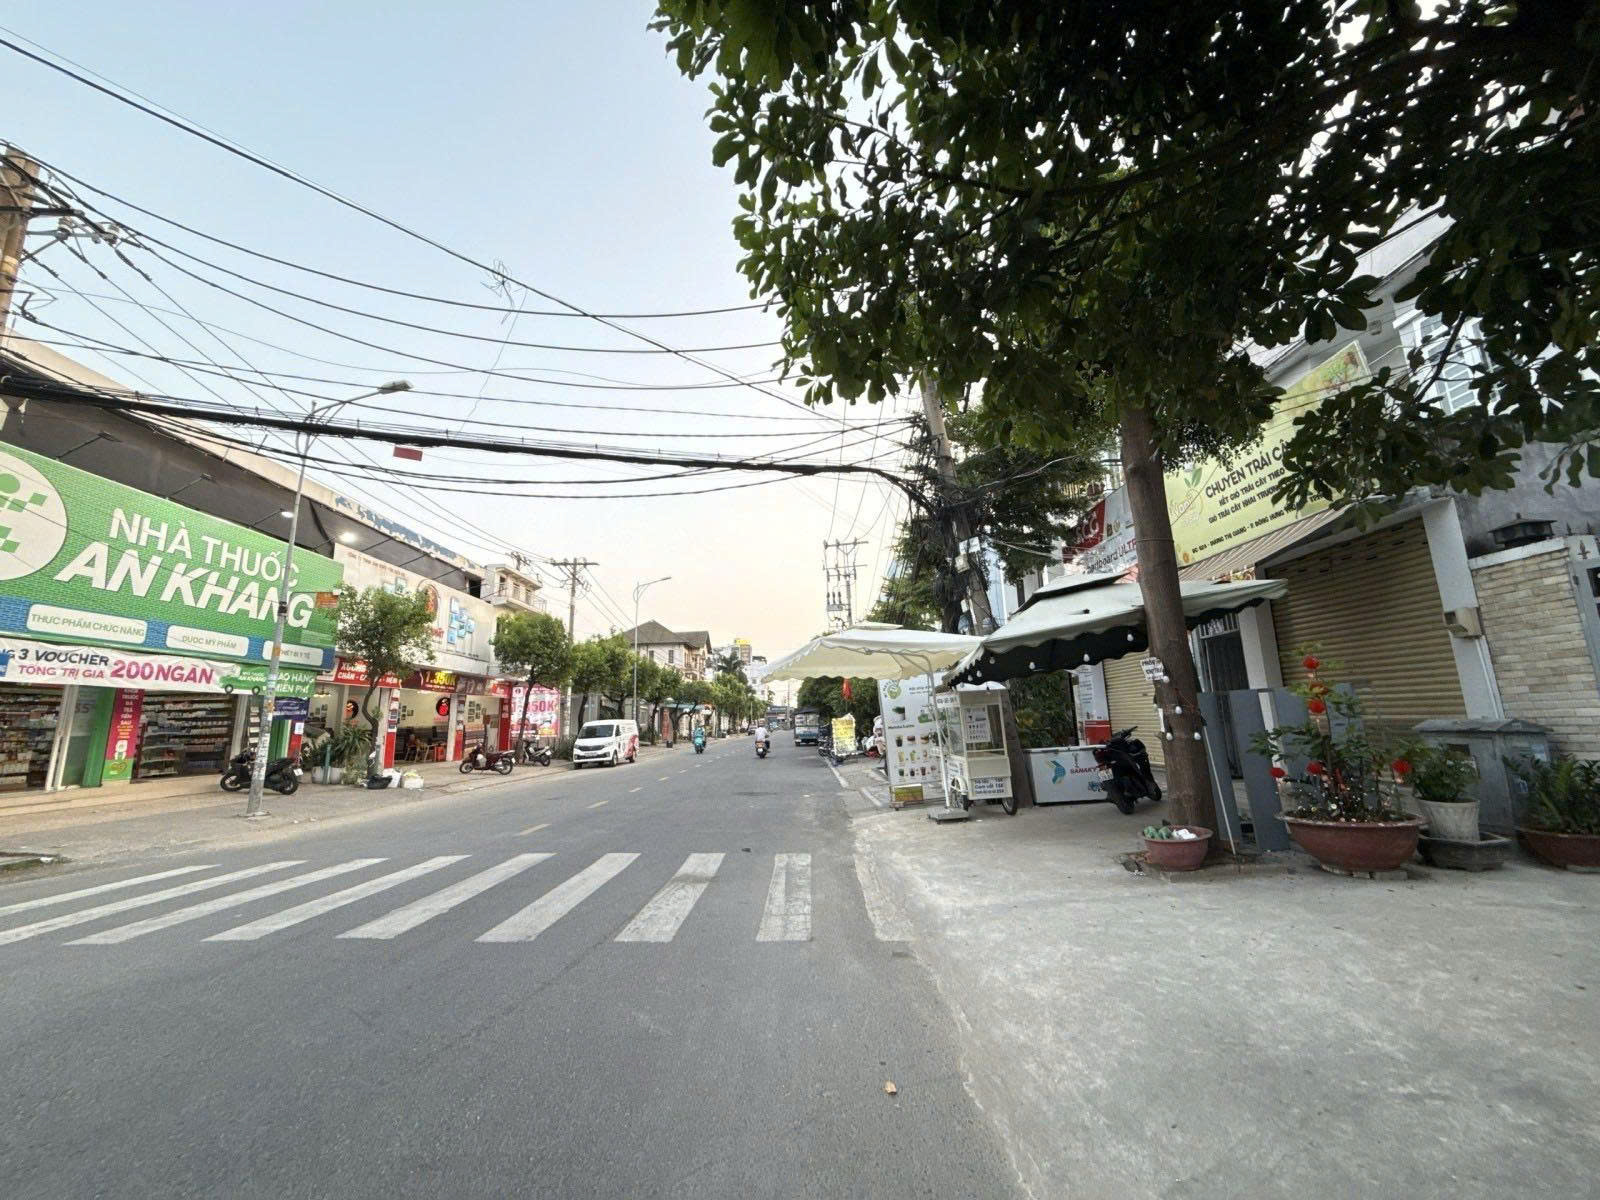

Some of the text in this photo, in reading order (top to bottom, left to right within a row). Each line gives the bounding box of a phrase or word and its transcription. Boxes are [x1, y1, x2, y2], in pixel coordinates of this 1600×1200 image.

[1245, 451, 1272, 475] TRÁI
[1240, 483, 1255, 495] TRÁI
[1267, 467, 1285, 481] THEO
[109, 508, 193, 559] NHÀ
[202, 535, 300, 588] THUỐC
[54, 541, 163, 598] AN
[159, 562, 315, 628] KHANG
[18, 648, 29, 660] 3
[35, 650, 109, 666] VOUCHER
